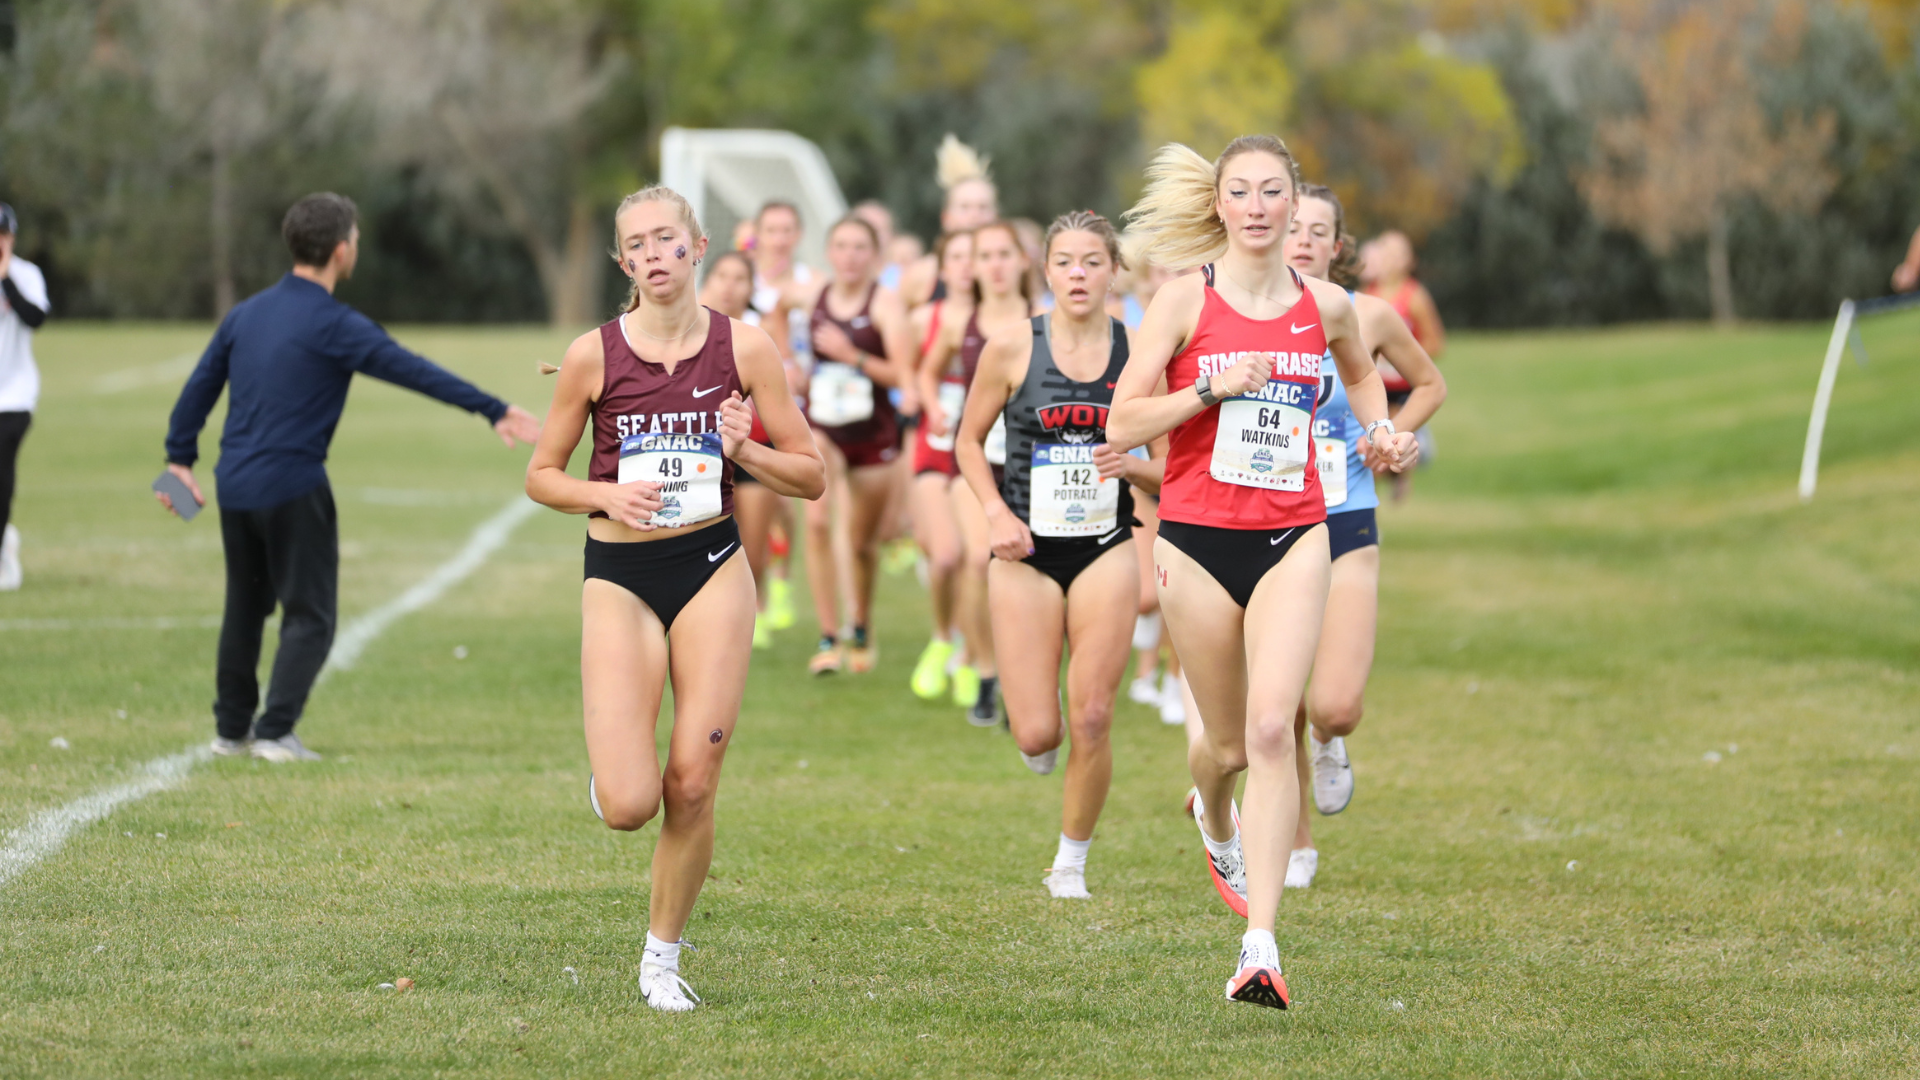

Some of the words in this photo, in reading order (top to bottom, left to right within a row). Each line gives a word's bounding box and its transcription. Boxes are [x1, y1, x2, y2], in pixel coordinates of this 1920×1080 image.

[1258, 407, 1280, 429] 64
[641, 434, 703, 451] GNAC
[1241, 429, 1290, 448] WATKINS
[1049, 446, 1095, 463] GNA
[658, 457, 682, 477] 49
[1062, 469, 1091, 485] 142
[1054, 489, 1098, 500] POTRATZ
